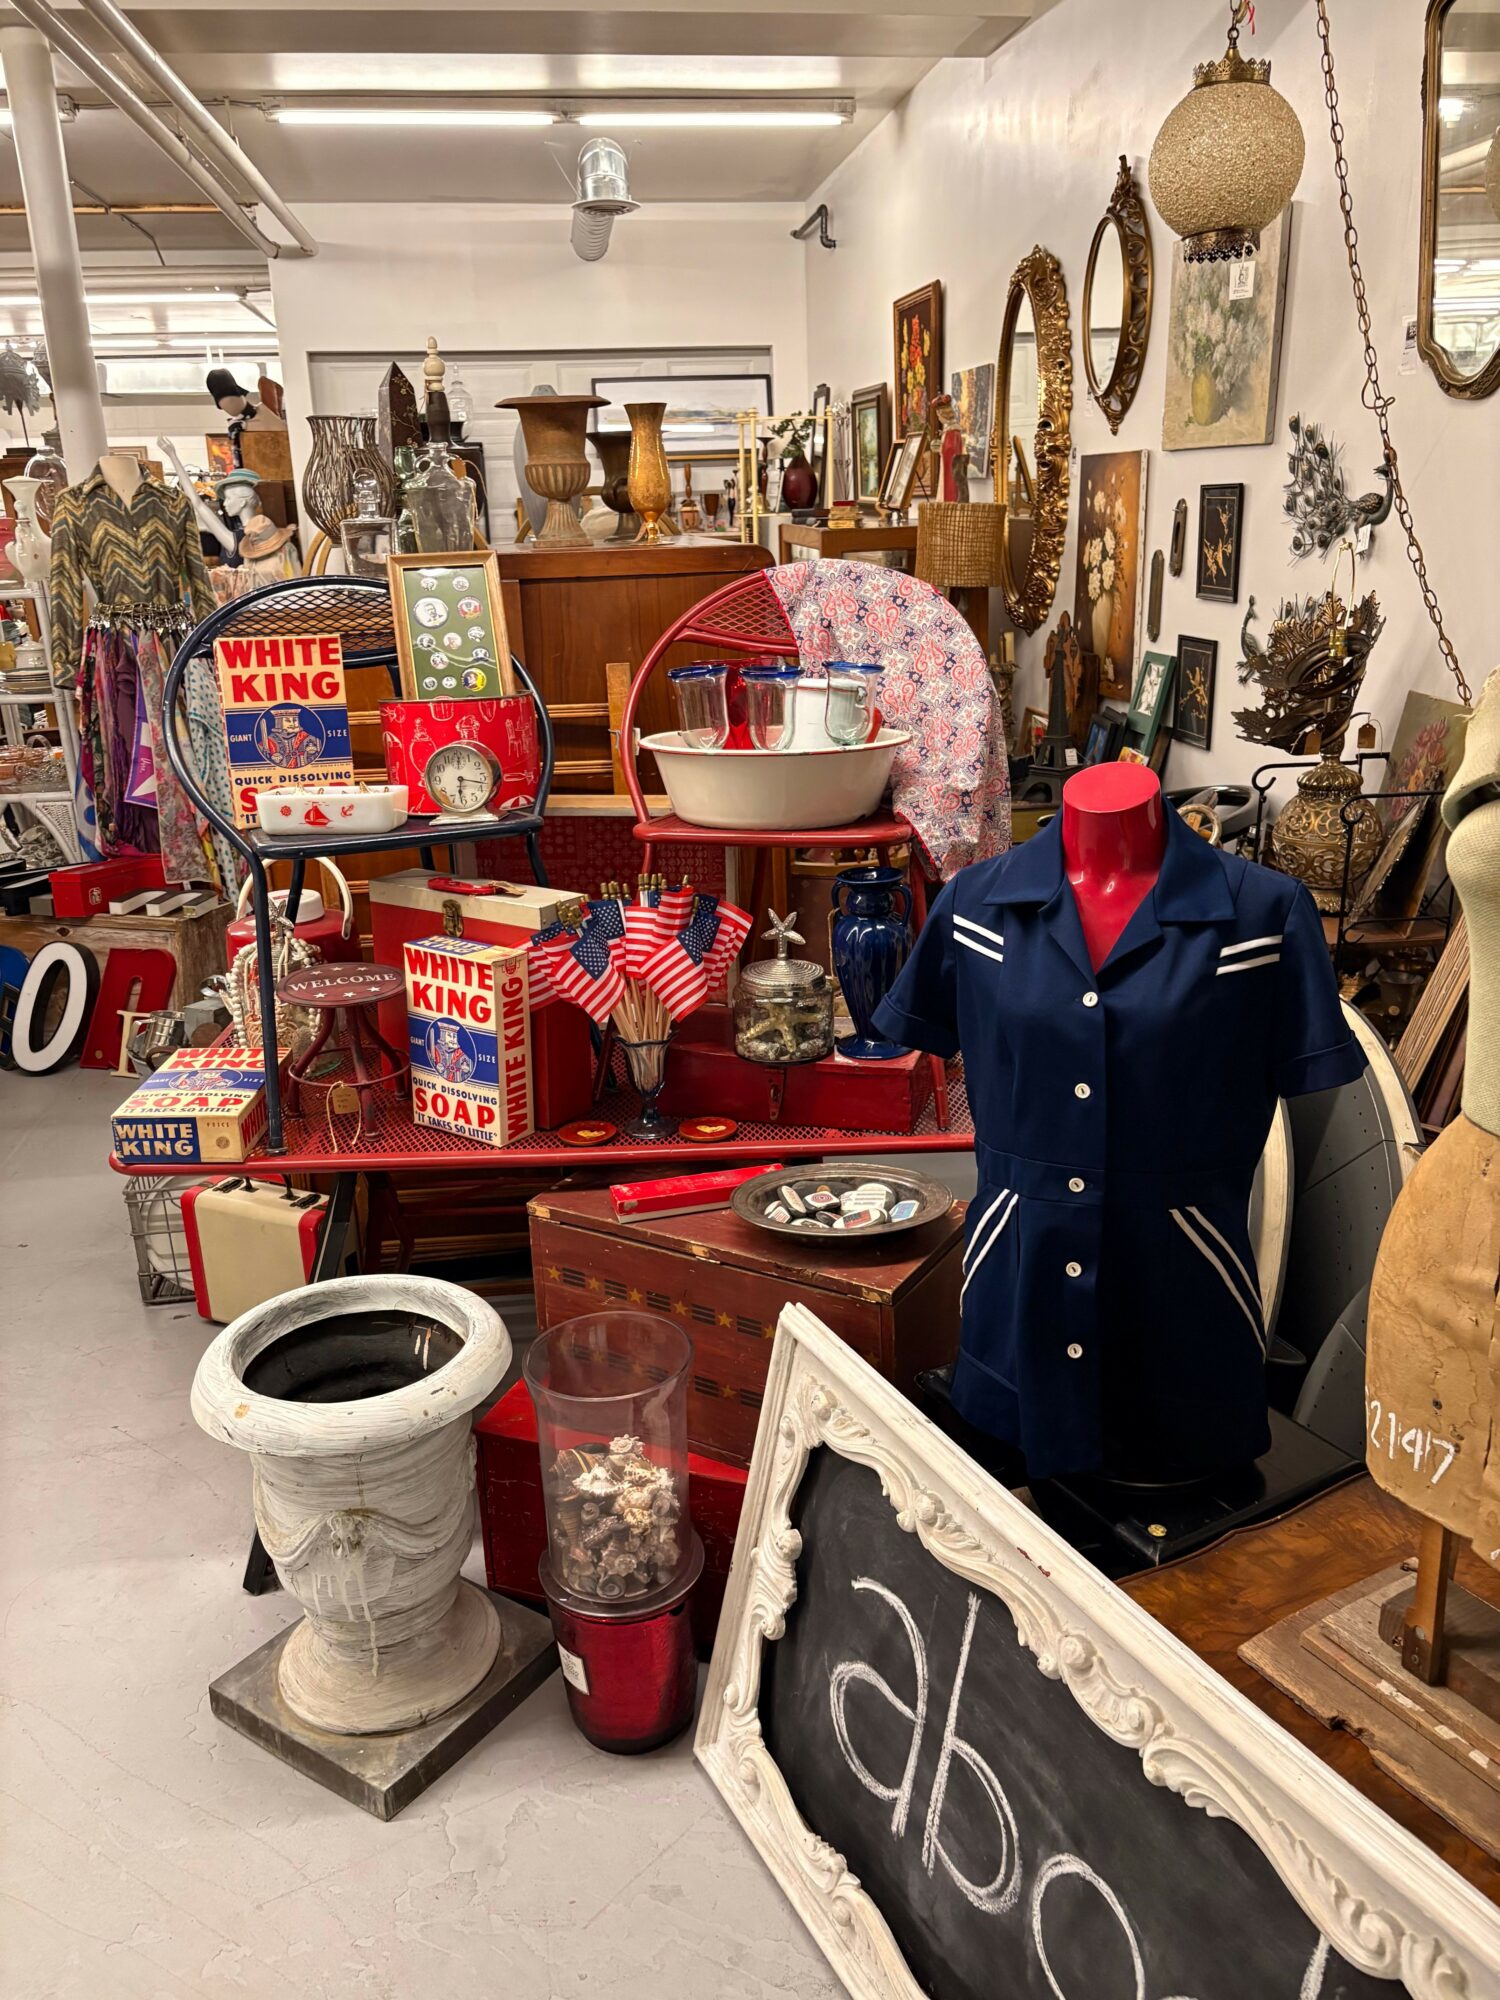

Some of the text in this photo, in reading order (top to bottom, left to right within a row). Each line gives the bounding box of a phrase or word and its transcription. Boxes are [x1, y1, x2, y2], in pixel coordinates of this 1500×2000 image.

[218, 637, 341, 669] WHITE
[231, 671, 340, 703] KING
[229, 734, 252, 743] GIANT
[327, 729, 348, 738] SIZE
[234, 771, 352, 786] QUICK DISSOLVING
[404, 946, 494, 992] WHITE
[288, 973, 397, 992] WELCOME
[412, 980, 492, 1024] KING
[478, 1053, 496, 1064] SIZE
[501, 976, 529, 1141] WHITE KING
[412, 1076, 437, 1091] QUICK
[441, 1085, 498, 1106] DISSOLVING
[126, 1097, 244, 1108] SOAP
[414, 1087, 496, 1129] SOAP
[241, 1093, 268, 1149] WHIT
[427, 1115, 453, 1131] TAKES
[454, 1124, 466, 1134] SO
[115, 1123, 194, 1139] WHITE
[122, 1140, 194, 1156] KING
